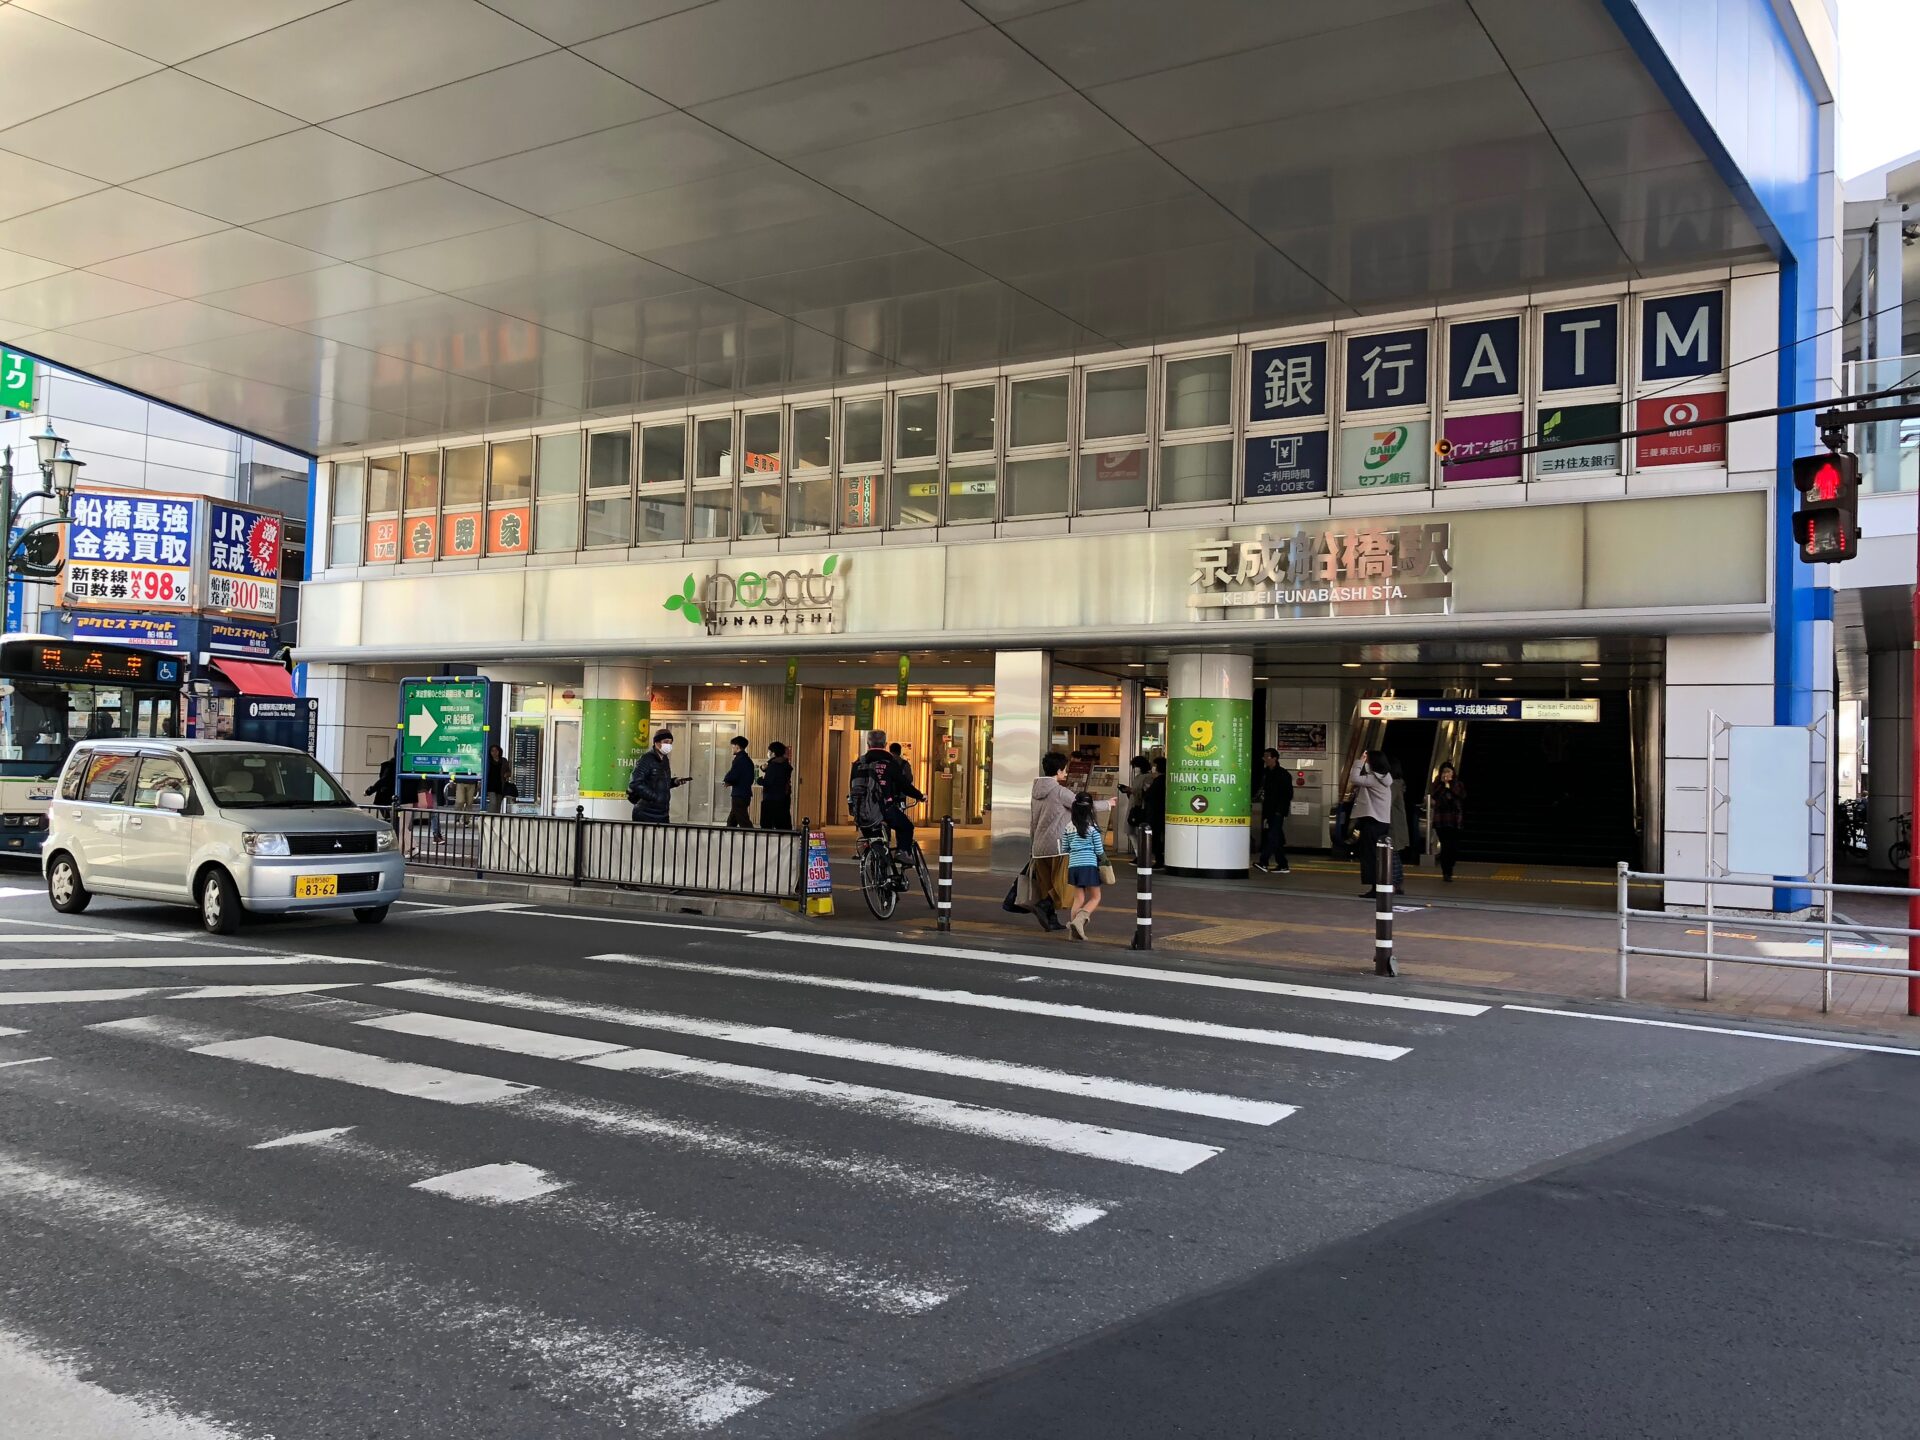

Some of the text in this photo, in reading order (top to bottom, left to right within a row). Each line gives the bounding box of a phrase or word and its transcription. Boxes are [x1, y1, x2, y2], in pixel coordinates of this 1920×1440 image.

[1669, 429, 1693, 438] MUFG
[1370, 444, 1398, 456] BANK
[1640, 442, 1721, 458] 三菱東京UFJ銀行
[1542, 454, 1617, 471] 三井住友銀行
[1262, 468, 1311, 482] ご利用時間
[1358, 471, 1411, 487] セブン銀行
[73, 497, 189, 534] 船橋最強
[215, 511, 245, 542] JR
[378, 524, 394, 541] 2F
[73, 528, 188, 565] 金券買取
[212, 541, 245, 573] 京成
[1190, 523, 1453, 588] 京成船橋駅
[71, 566, 129, 583] 新幹線
[71, 582, 128, 598] 回数券
[131, 570, 142, 599] MAX
[144, 571, 186, 602] 98%
[211, 576, 231, 593] 船橋
[210, 590, 230, 607] 発着
[230, 580, 259, 610] 300
[1275, 586, 1368, 604] FUNABASHI
[1371, 585, 1408, 600] STA.
[1454, 704, 1508, 715] 京成船橋駅
[442, 714, 452, 725] JR
[1170, 772, 1237, 785] THANK 9 FAIR
[305, 884, 336, 896] 83-62
